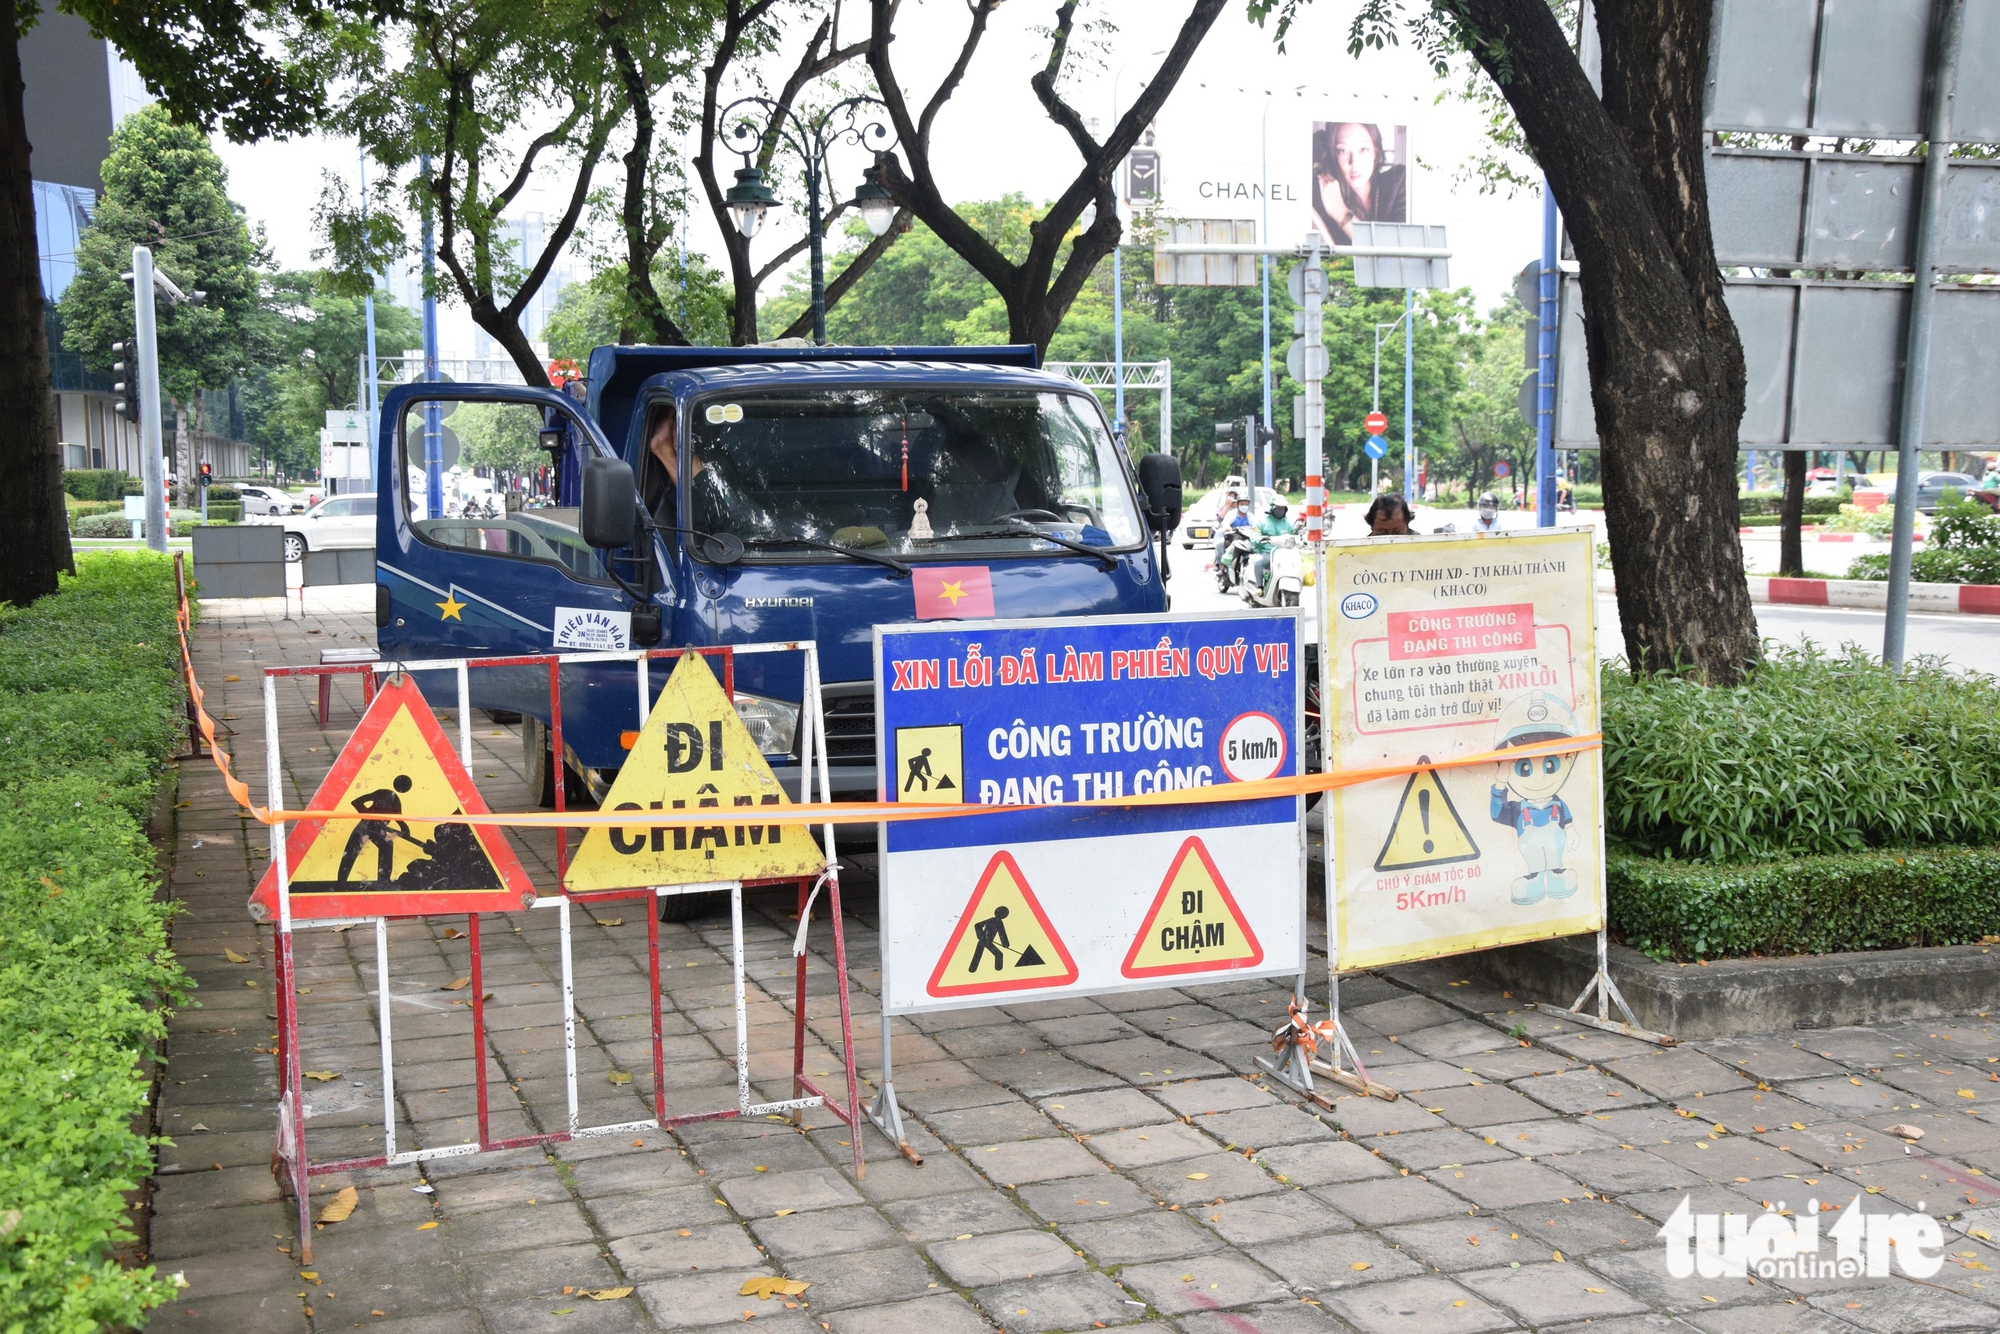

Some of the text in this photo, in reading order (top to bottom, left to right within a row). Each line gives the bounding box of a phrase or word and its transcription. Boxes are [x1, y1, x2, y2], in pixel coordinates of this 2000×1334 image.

[1199, 181, 1297, 201] CHANEL
[1353, 569, 1387, 585] CÔNG
[1391, 570, 1407, 582] TY
[1409, 569, 1443, 582] TNHH
[1446, 567, 1462, 580] XD
[1472, 566, 1490, 578] TM
[1525, 559, 1566, 575] THÀNH
[745, 596, 814, 608] HYUNDAI
[1345, 600, 1372, 612] KHACO
[558, 615, 583, 644] TRIỆU
[586, 612, 610, 628] VĂN
[1408, 611, 1517, 633] CÔNG TRƯỜNG
[1403, 630, 1524, 654] ĐANG THI CÔNG
[892, 637, 1289, 691] XIN LỖI ĐÃ LÀM PHIỀN QUÝ VỊ!
[1363, 656, 1538, 681] Xe lớn ra vào thường xuyên
[1408, 684, 1425, 698] tôi
[1429, 681, 1464, 696] thành
[1469, 679, 1494, 694] thật
[1497, 672, 1527, 690] XIN
[1530, 665, 1557, 687] LỖI
[1367, 709, 1383, 724] đã
[1386, 707, 1410, 722] làm
[1415, 704, 1436, 719] cản
[1441, 701, 1458, 716] trở
[1461, 699, 1484, 715] Quý
[664, 720, 724, 774] ĐI
[988, 712, 1203, 760] CÔNG TRƯỜNG
[1228, 737, 1278, 761] 5 km/h
[979, 760, 1213, 805] ĐANG THI CÔNG
[609, 783, 781, 860] CHẬM
[1376, 865, 1481, 890] CHÚ Ý GIẢM TỐC ĐỘ
[1181, 890, 1203, 916] ĐI
[1396, 885, 1466, 911] 5Km/h
[1161, 919, 1225, 954] CHẬM
